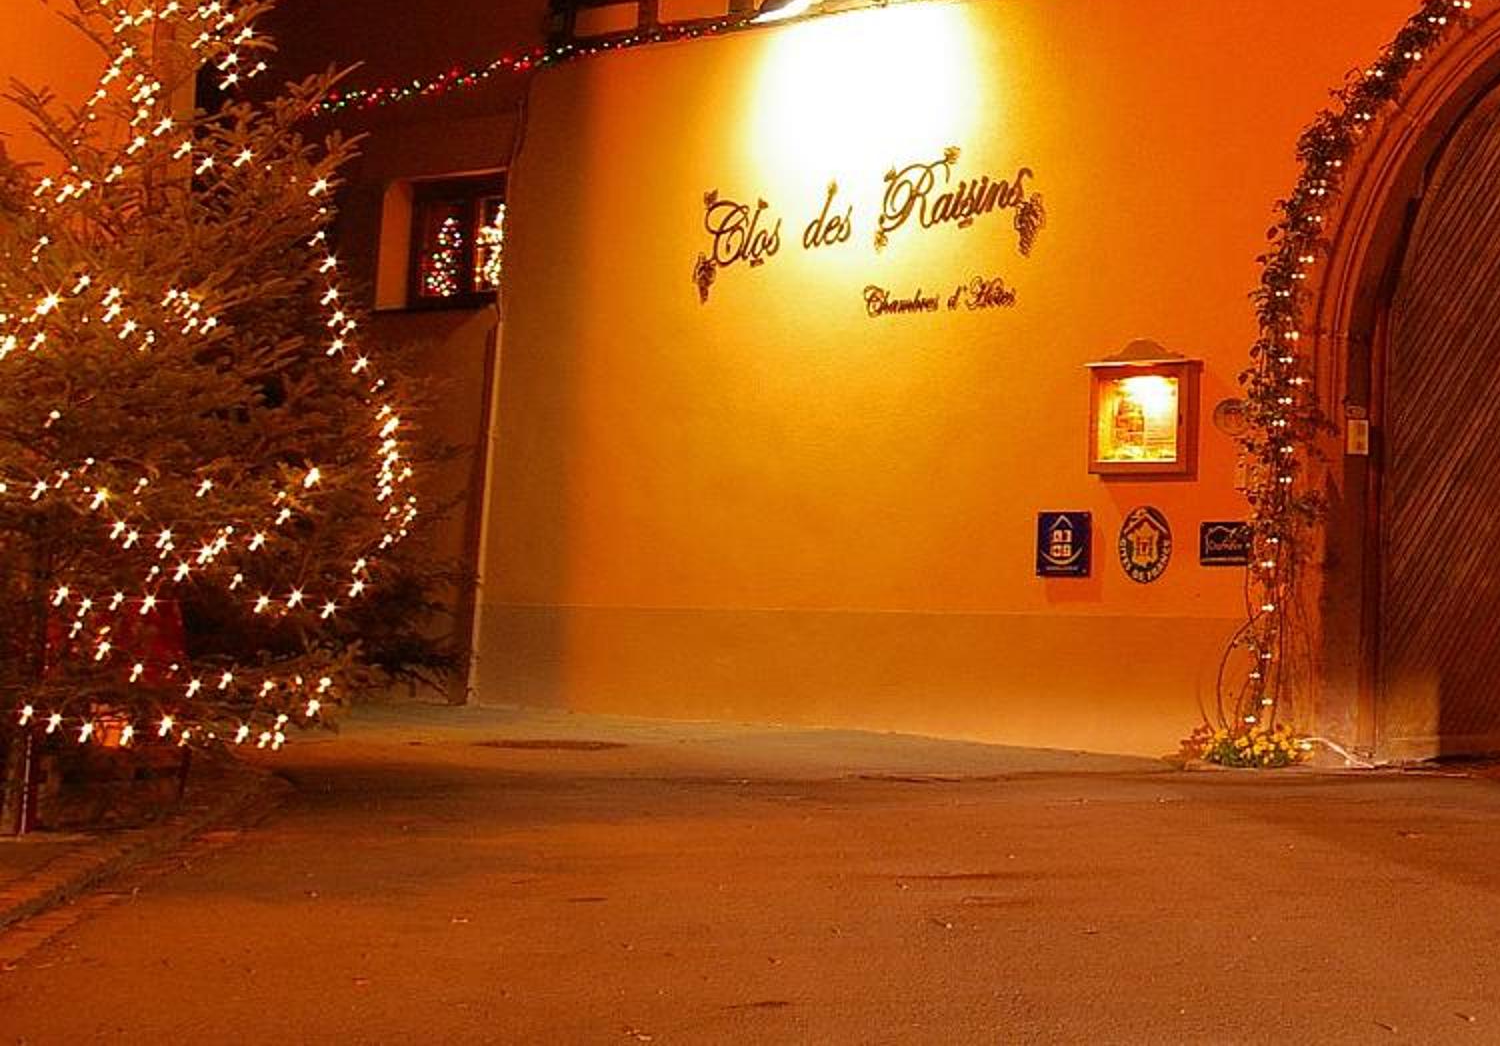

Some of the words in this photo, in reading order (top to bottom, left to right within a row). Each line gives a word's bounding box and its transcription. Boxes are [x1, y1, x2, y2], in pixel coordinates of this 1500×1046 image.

[703, 190, 782, 267] Clos
[803, 181, 852, 249] des
[876, 157, 1036, 234] Raisins
[863, 284, 939, 317] Chambres
